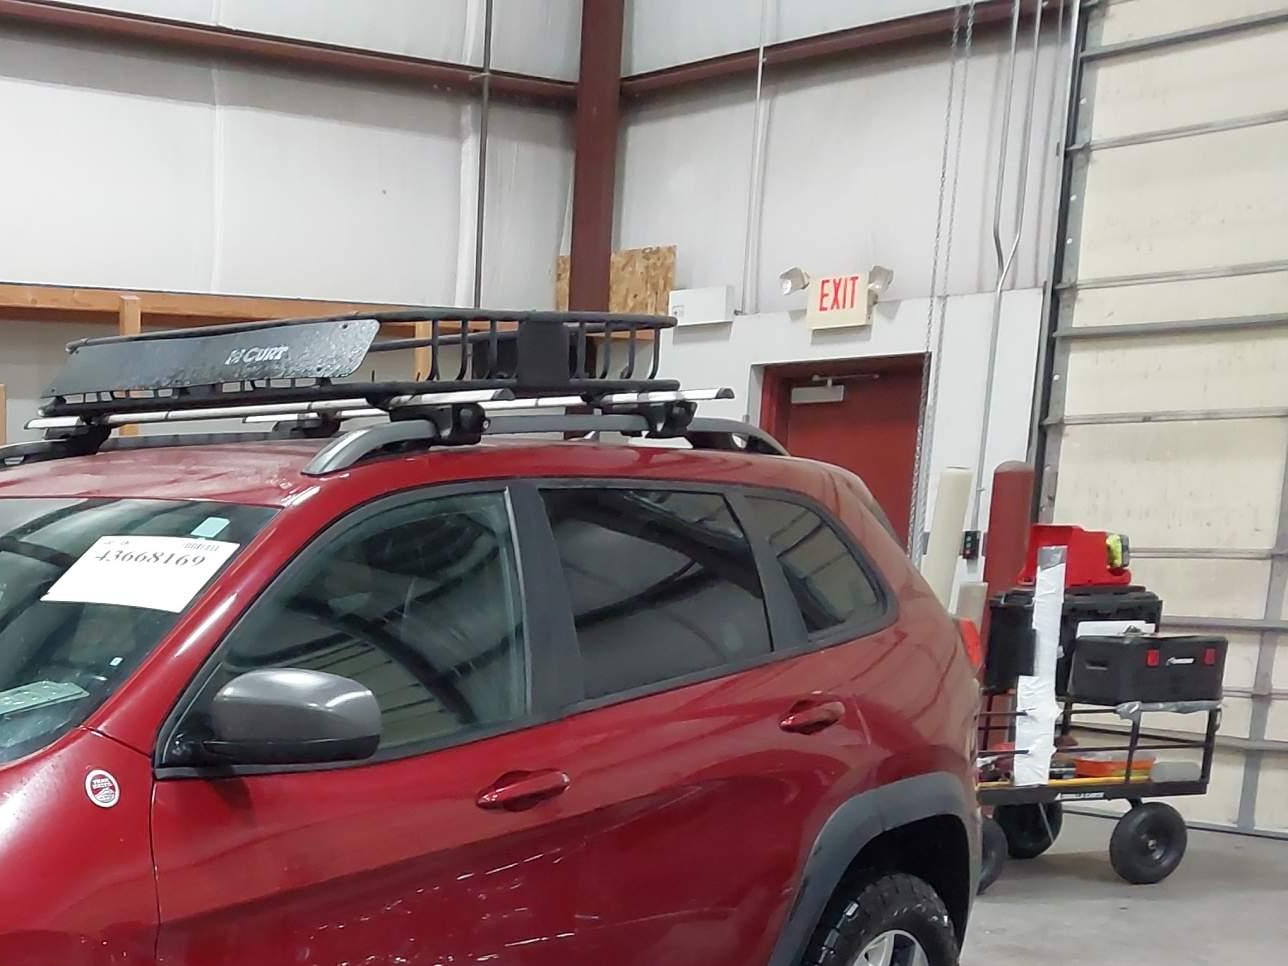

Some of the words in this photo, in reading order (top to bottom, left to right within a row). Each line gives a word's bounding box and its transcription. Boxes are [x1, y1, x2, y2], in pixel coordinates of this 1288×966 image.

[819, 276, 859, 311] EXIT
[243, 346, 289, 363] CURT
[95, 549, 207, 567] 43668169
